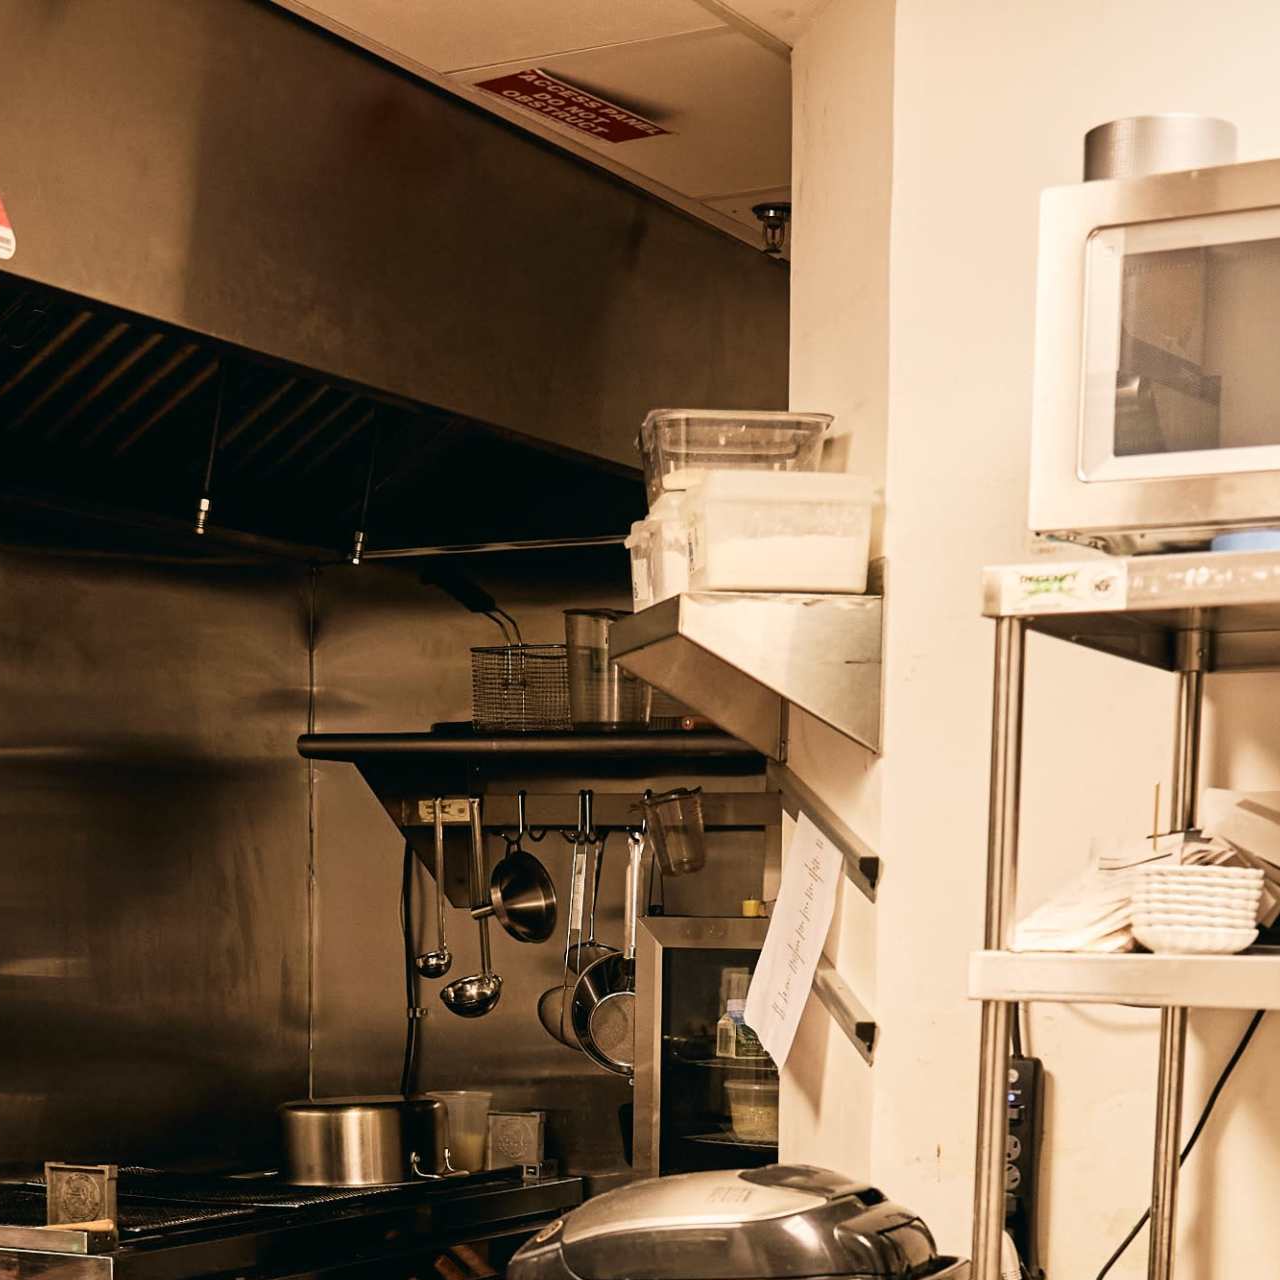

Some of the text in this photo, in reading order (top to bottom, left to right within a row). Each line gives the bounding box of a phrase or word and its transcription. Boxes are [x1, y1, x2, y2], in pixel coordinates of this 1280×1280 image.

[501, 90, 610, 134] OBSTRUCT
[518, 74, 660, 134] ACCESS PANEL
[533, 92, 611, 124] DO NOT
